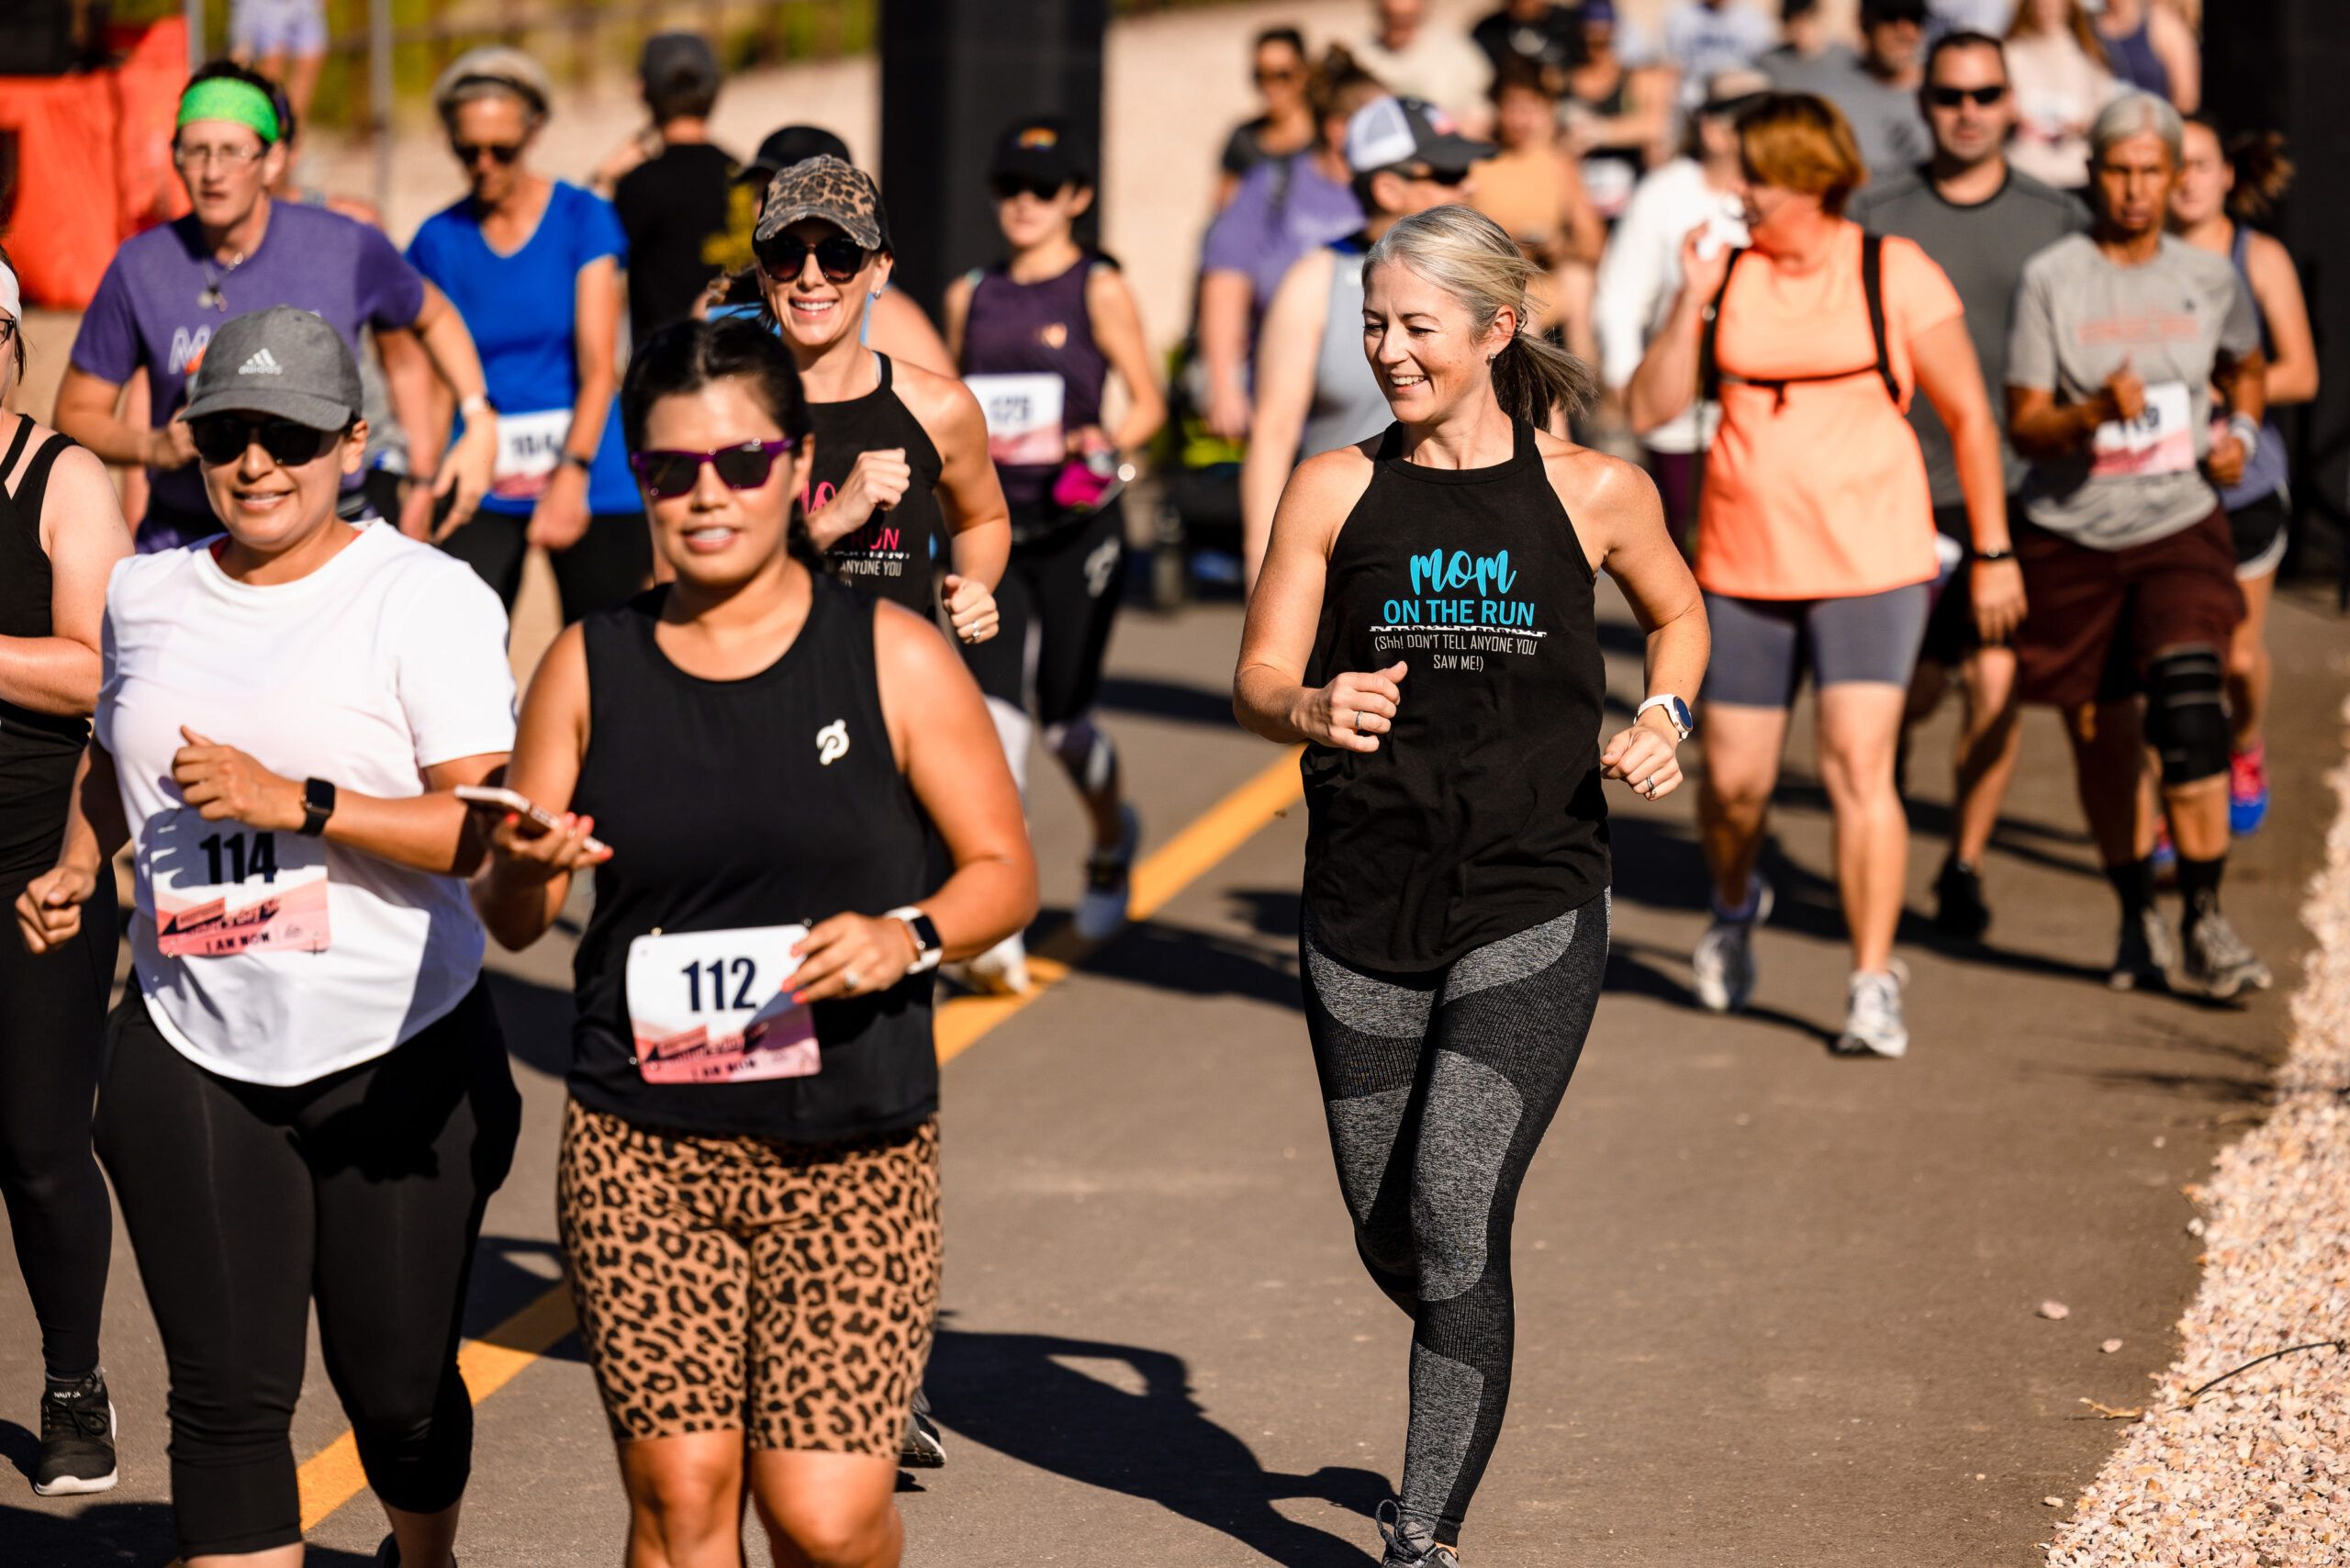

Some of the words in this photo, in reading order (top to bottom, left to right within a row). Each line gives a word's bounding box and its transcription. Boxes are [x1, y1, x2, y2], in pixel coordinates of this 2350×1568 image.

[840, 559, 881, 576] ANYONE
[883, 561, 902, 577] YOU
[1410, 548, 1517, 598] mom
[1383, 599, 1420, 624] ON
[1426, 599, 1474, 623] THE
[1481, 600, 1535, 627] RUN
[1374, 634, 1404, 653] (Shh!
[1407, 634, 1439, 650] DON'T
[1442, 634, 1468, 650] TELL
[1470, 635, 1514, 654] ANYONE
[1516, 638, 1538, 655] YOU
[1433, 655, 1458, 670] SAW
[1460, 655, 1484, 673] ME!)
[198, 832, 278, 885] 114
[681, 957, 757, 1012] 112
[53, 1391, 82, 1399] NAUTCA
